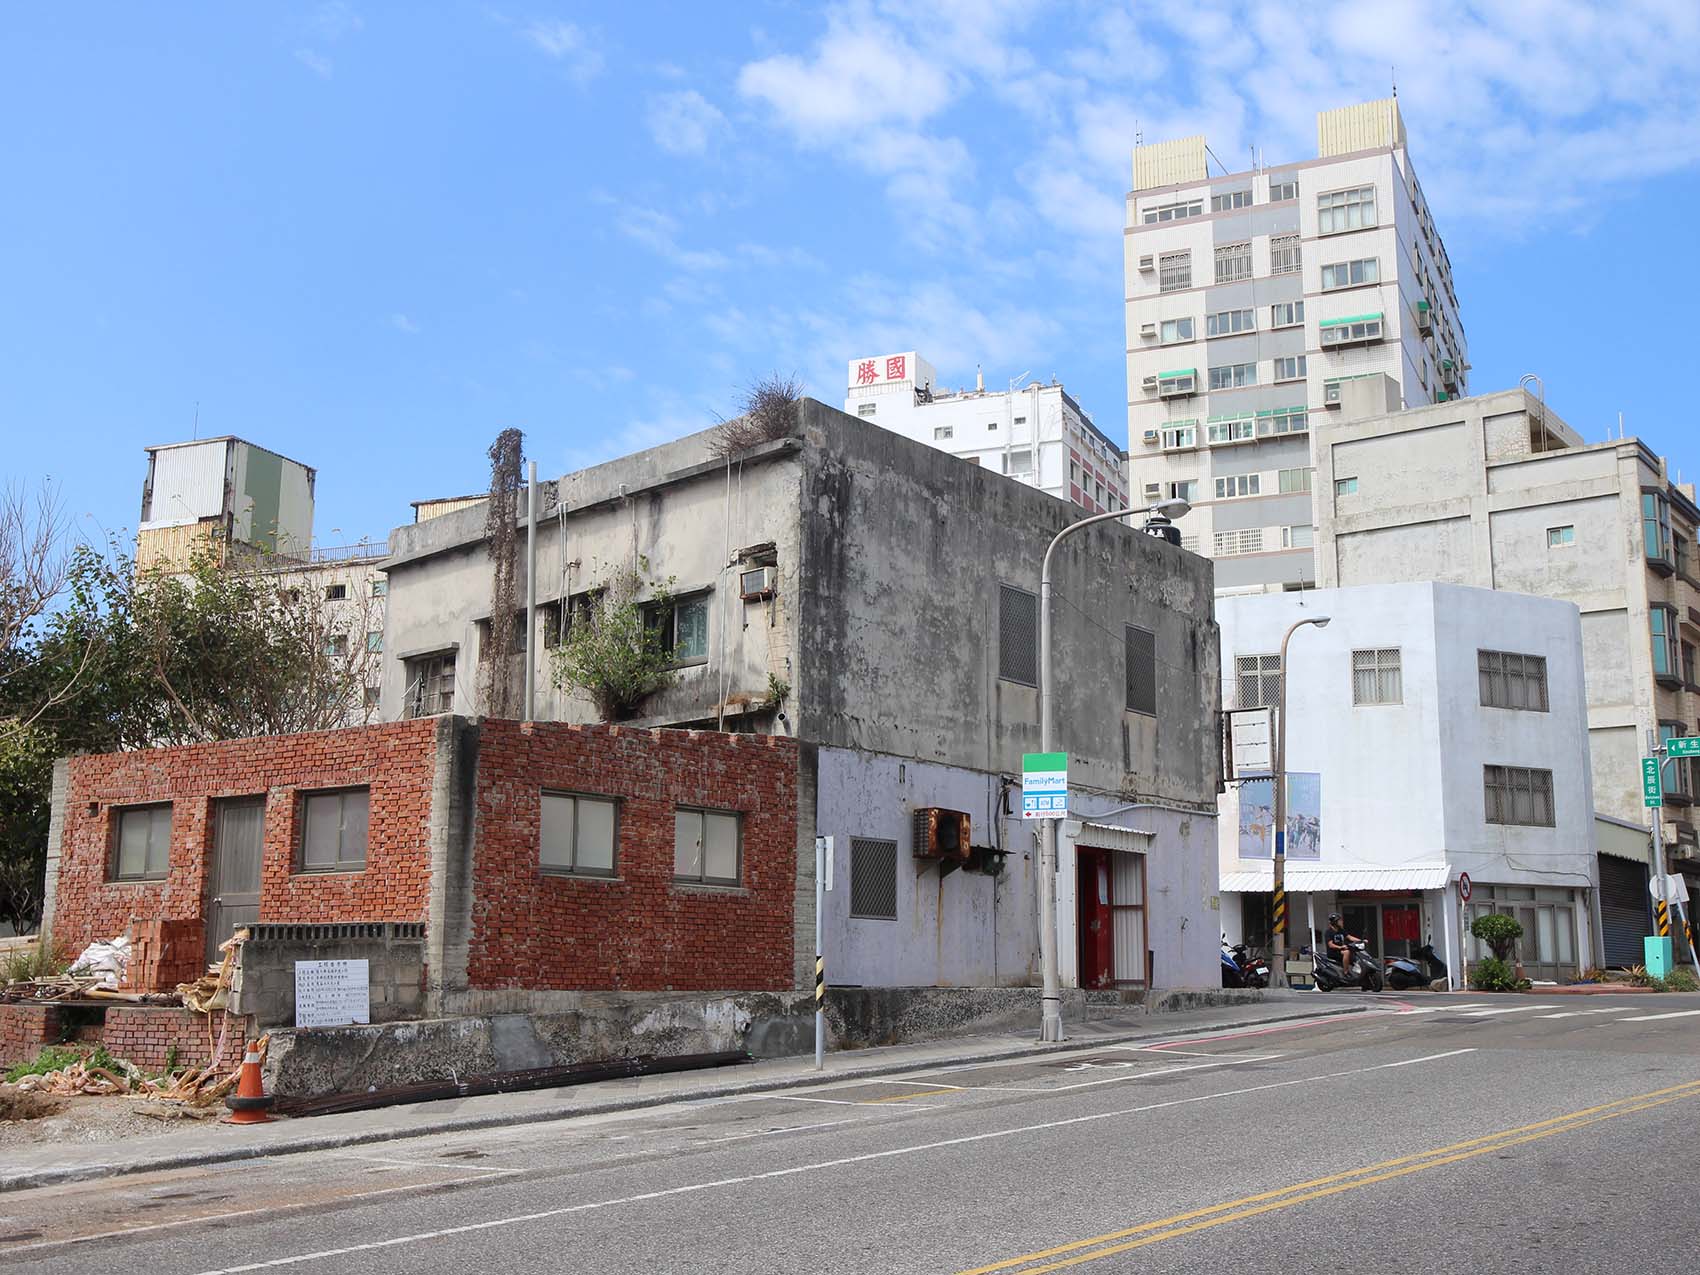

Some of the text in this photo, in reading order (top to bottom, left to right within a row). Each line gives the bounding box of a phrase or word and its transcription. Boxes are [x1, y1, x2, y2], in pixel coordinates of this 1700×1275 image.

[857, 356, 905, 384] 勝國
[1678, 739, 1700, 748] 新生
[1024, 777, 1065, 786] FamilyMart
